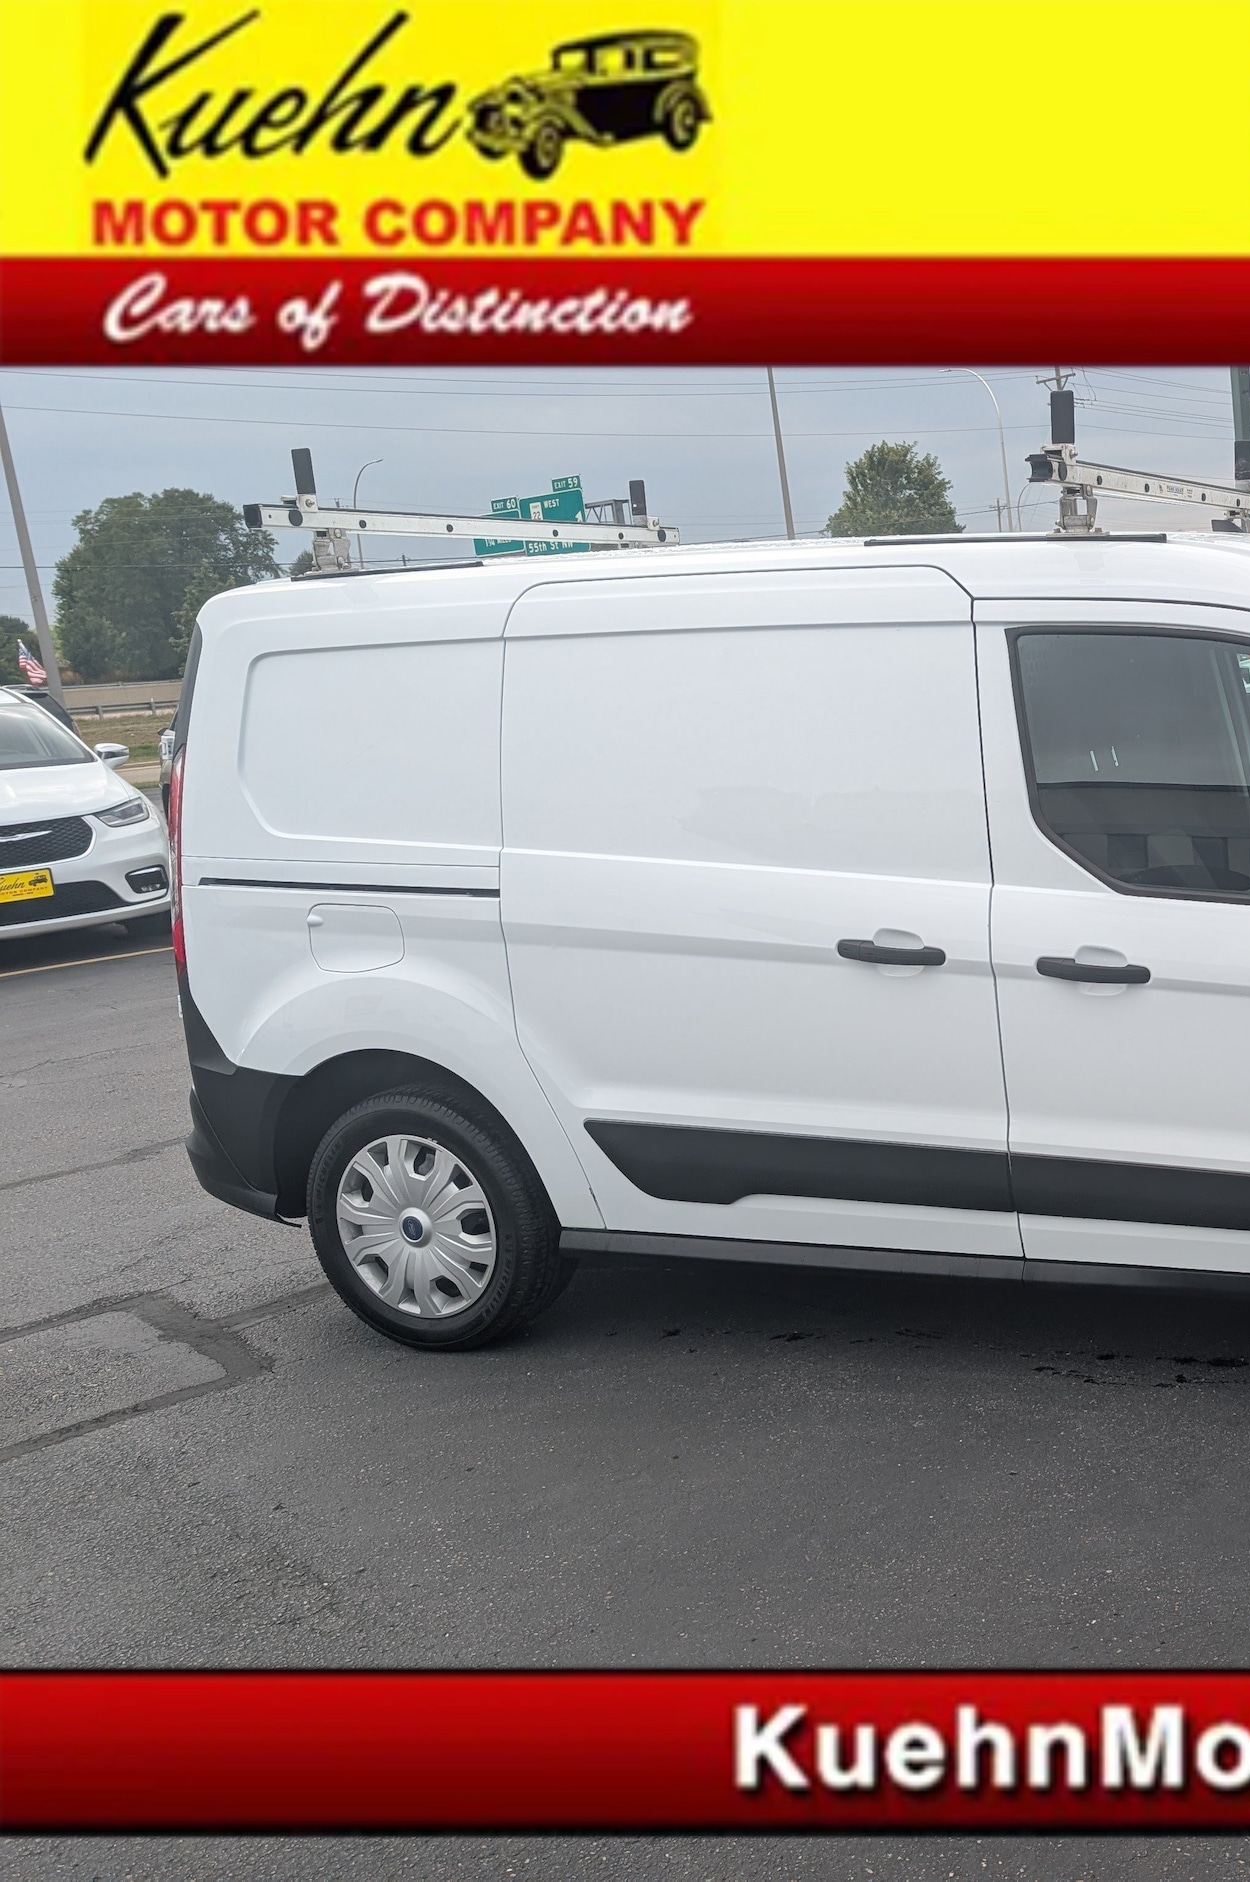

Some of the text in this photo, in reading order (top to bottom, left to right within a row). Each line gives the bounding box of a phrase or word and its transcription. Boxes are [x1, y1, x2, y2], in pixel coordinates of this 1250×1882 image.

[554, 477, 578, 490] EXIT 59
[493, 499, 516, 510] EXIT 60
[543, 499, 560, 509] WEST
[532, 511, 541, 520] 22
[528, 542, 548, 553] 55th
[550, 541, 559, 550] St
